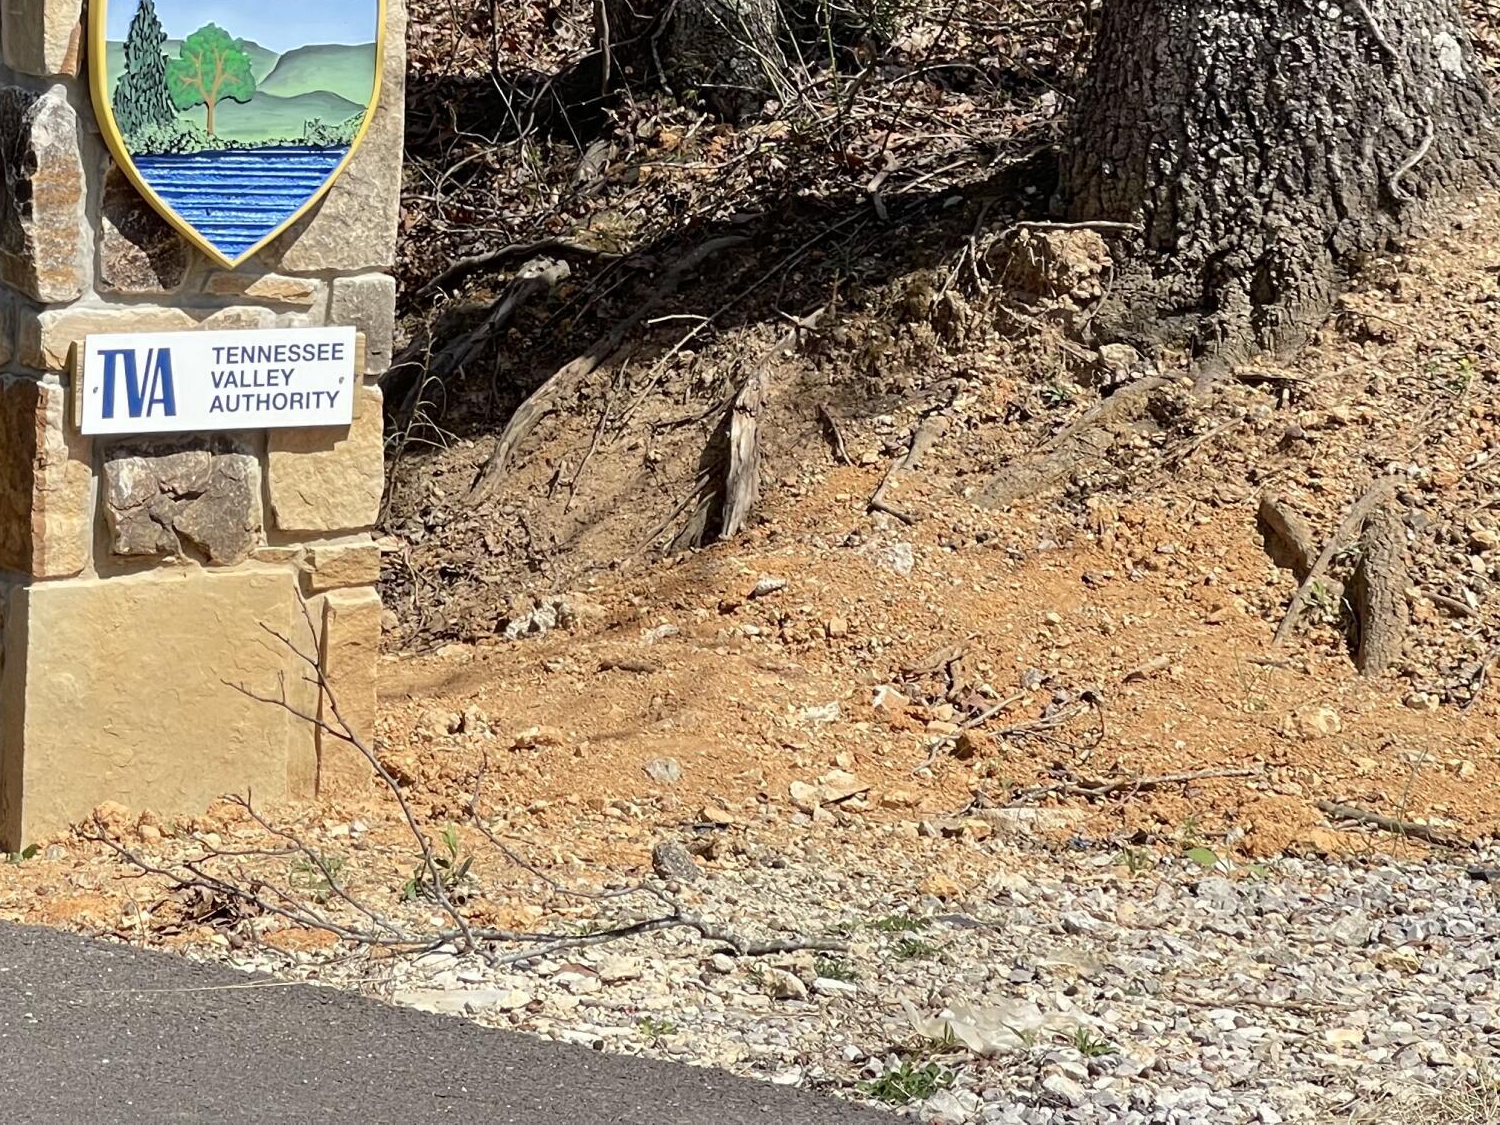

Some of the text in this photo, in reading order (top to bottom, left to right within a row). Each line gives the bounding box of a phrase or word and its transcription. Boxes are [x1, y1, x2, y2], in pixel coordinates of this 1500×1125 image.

[212, 343, 345, 365] TENNESSEE
[97, 347, 177, 419] TVA
[210, 368, 295, 389] VALLEY
[209, 390, 340, 413] AUTHORITY
